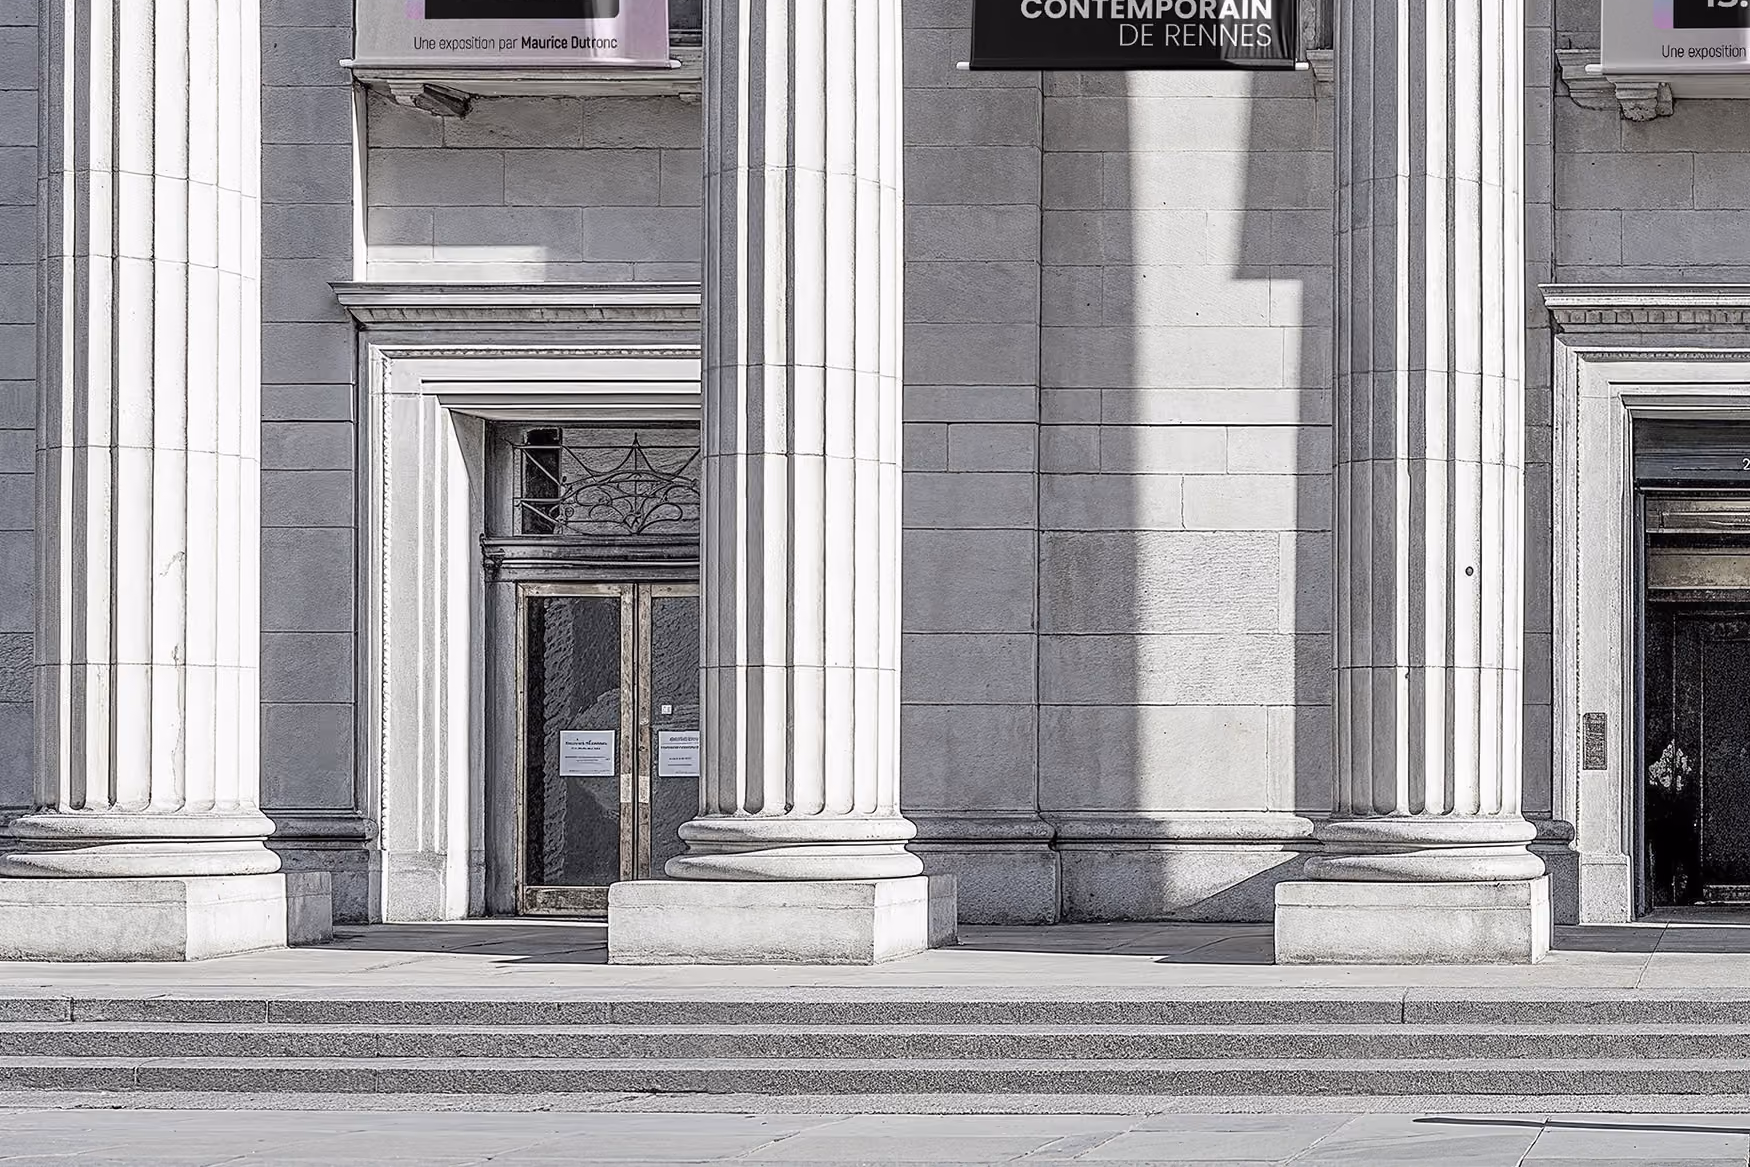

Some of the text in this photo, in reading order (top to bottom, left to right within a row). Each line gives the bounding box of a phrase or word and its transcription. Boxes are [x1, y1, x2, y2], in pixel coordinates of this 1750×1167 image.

[413, 35, 618, 51] Une exposition par Maurice Dutronc
[1119, 24, 1272, 47] DE RENNES
[1661, 45, 1685, 58] Une
[1688, 44, 1747, 60] exposition
